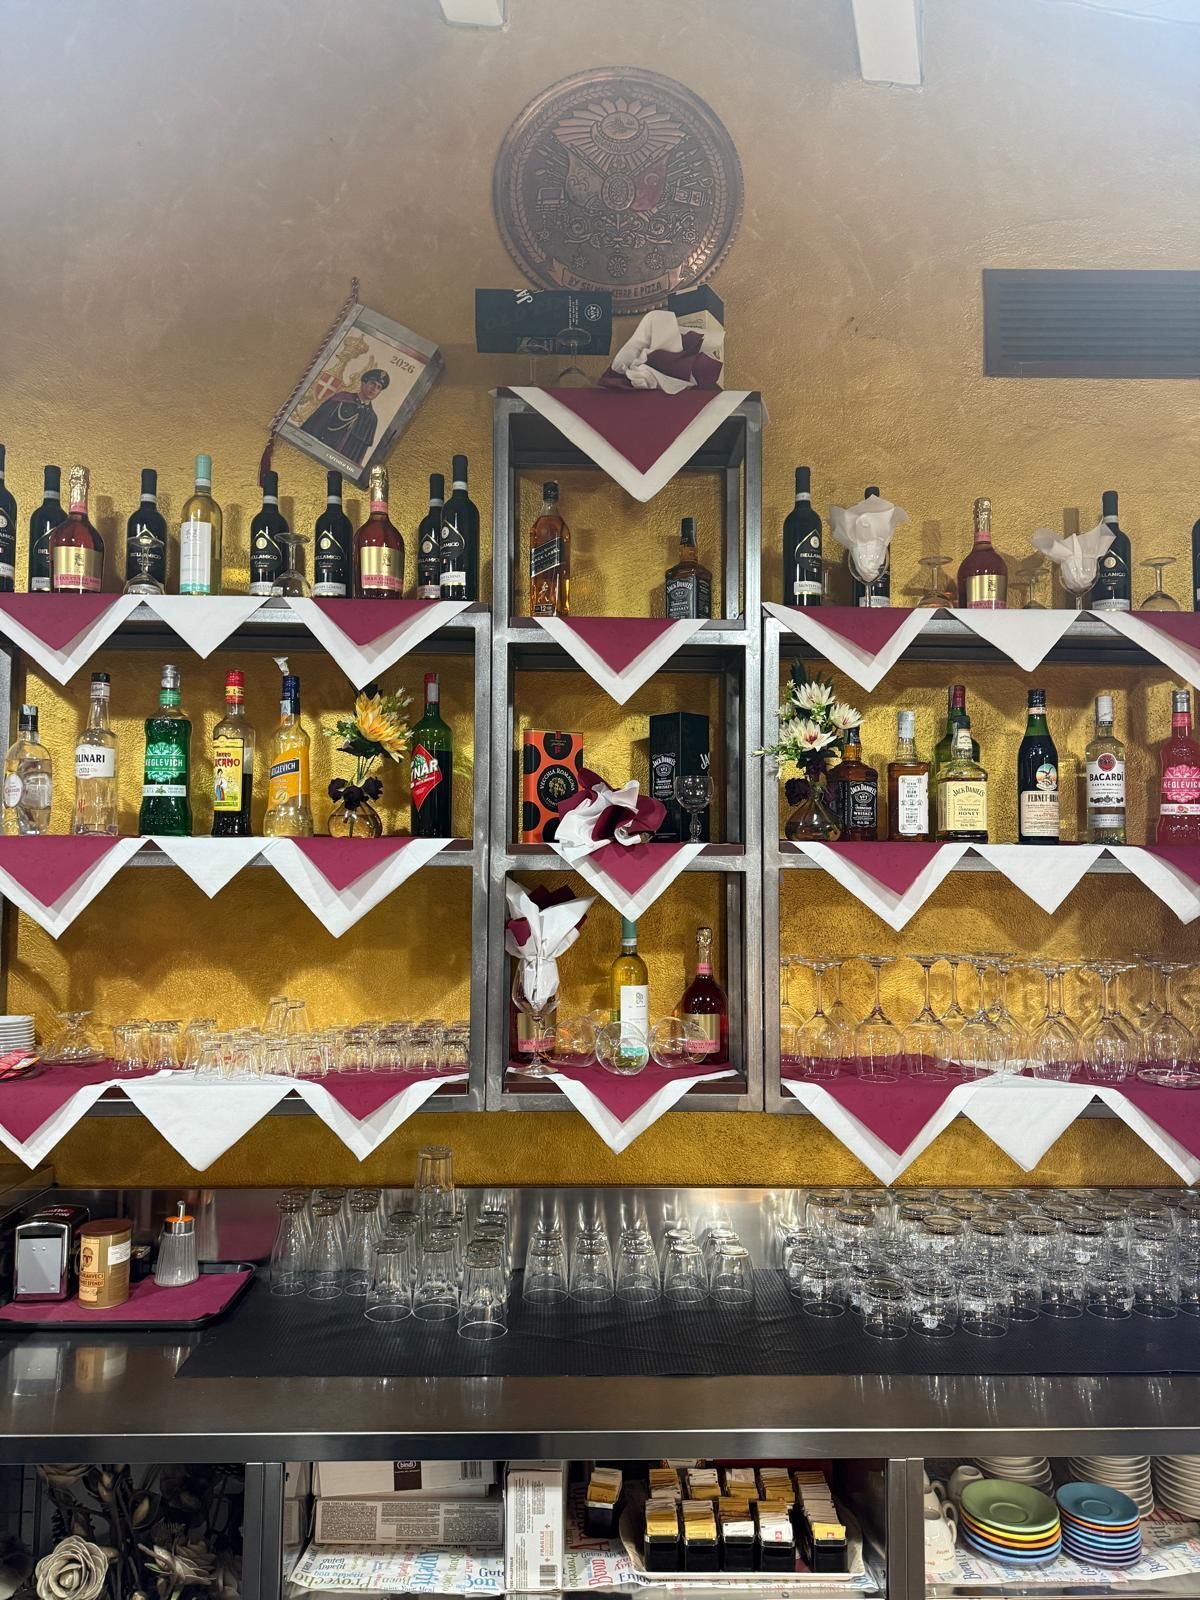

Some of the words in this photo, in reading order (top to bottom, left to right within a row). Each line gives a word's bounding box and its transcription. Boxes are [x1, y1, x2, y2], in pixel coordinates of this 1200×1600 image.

[390, 355, 415, 374] 2026
[539, 768, 556, 790] VECCHIA
[556, 767, 576, 791] ROMAGNA
[850, 785, 861, 795] JACK
[1163, 781, 1200, 789] KEGLEVIC
[952, 788, 966, 798] JACK
[479, 1568, 506, 1578] Gute
[294, 1572, 373, 1589] Provecho
